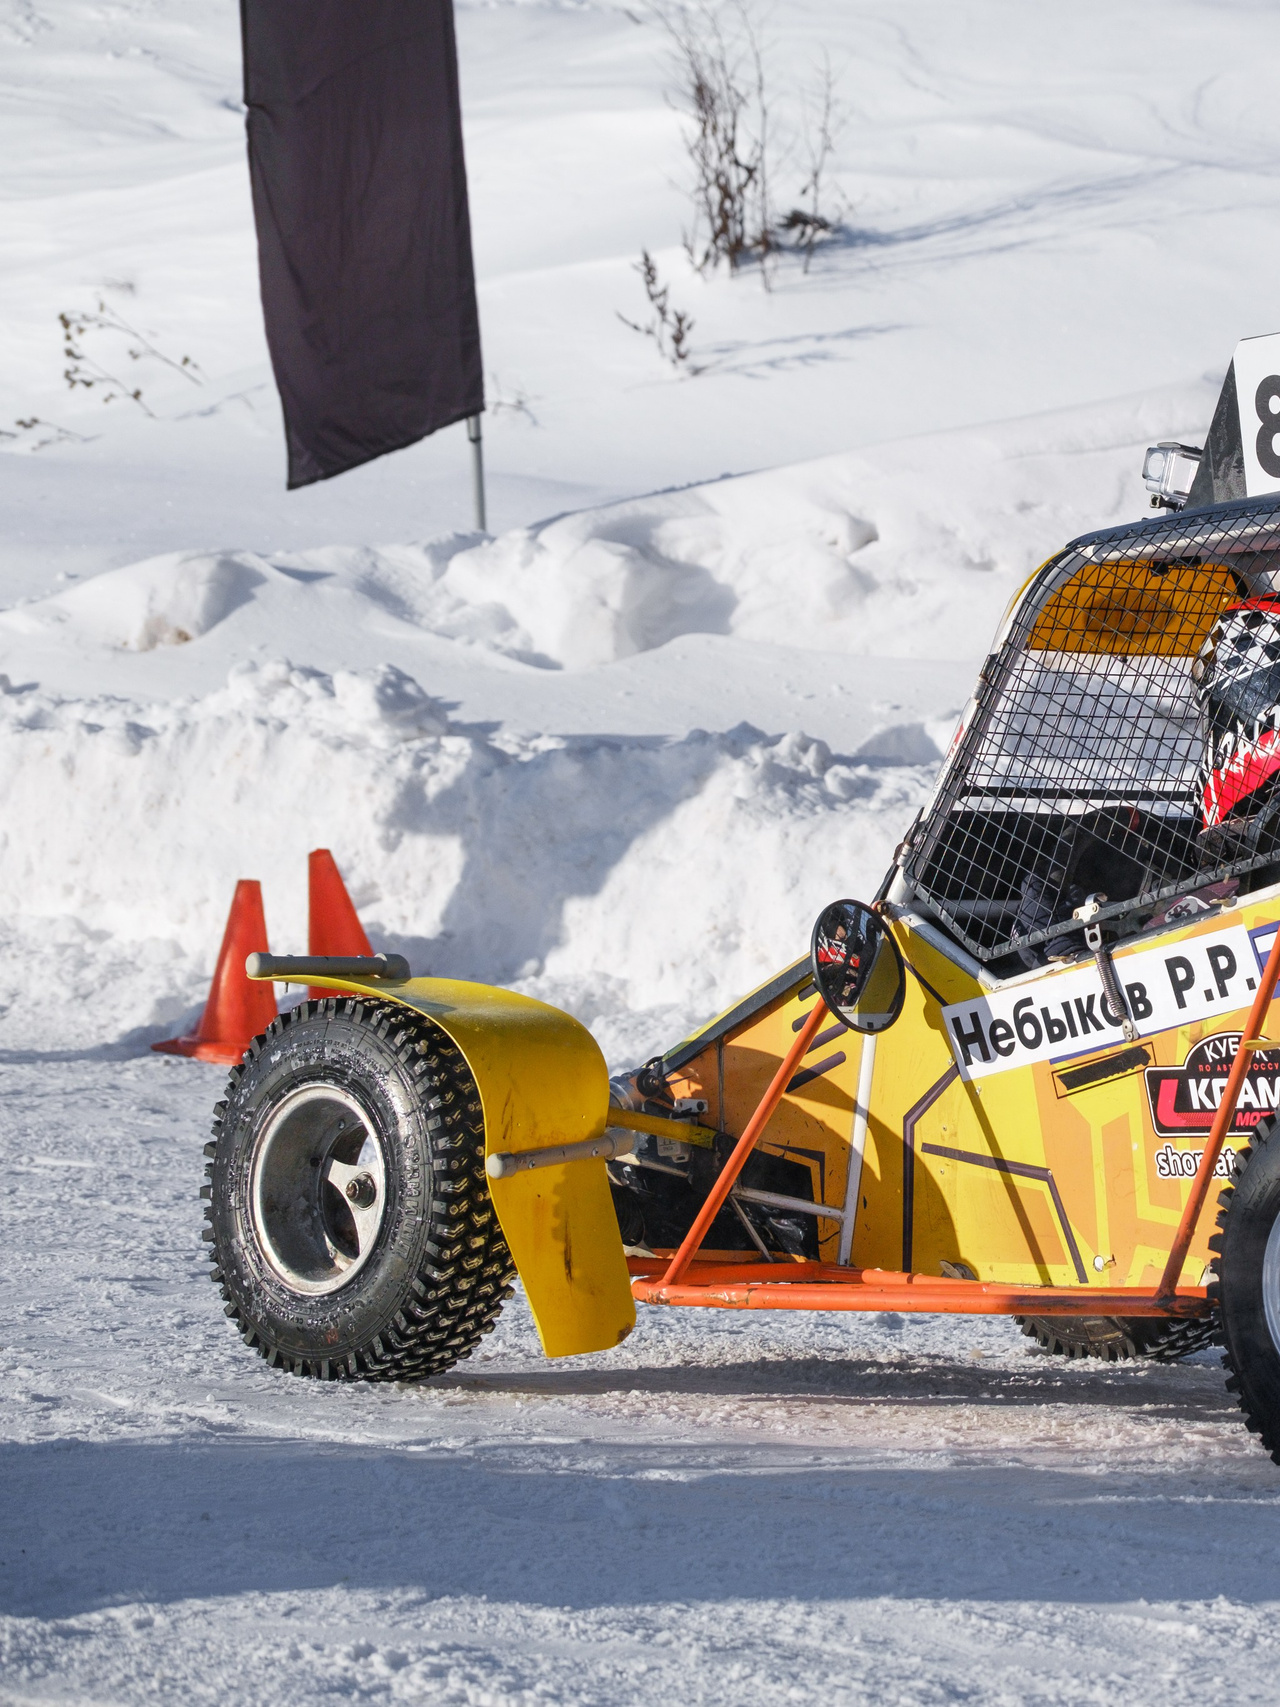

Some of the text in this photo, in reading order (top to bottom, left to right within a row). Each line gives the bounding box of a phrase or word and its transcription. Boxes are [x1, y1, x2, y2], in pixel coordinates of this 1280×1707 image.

[950, 943, 1258, 1067] Небыков Р.Р.
[1203, 1037, 1269, 1063] КУБК
[1198, 1063, 1211, 1072] ПО
